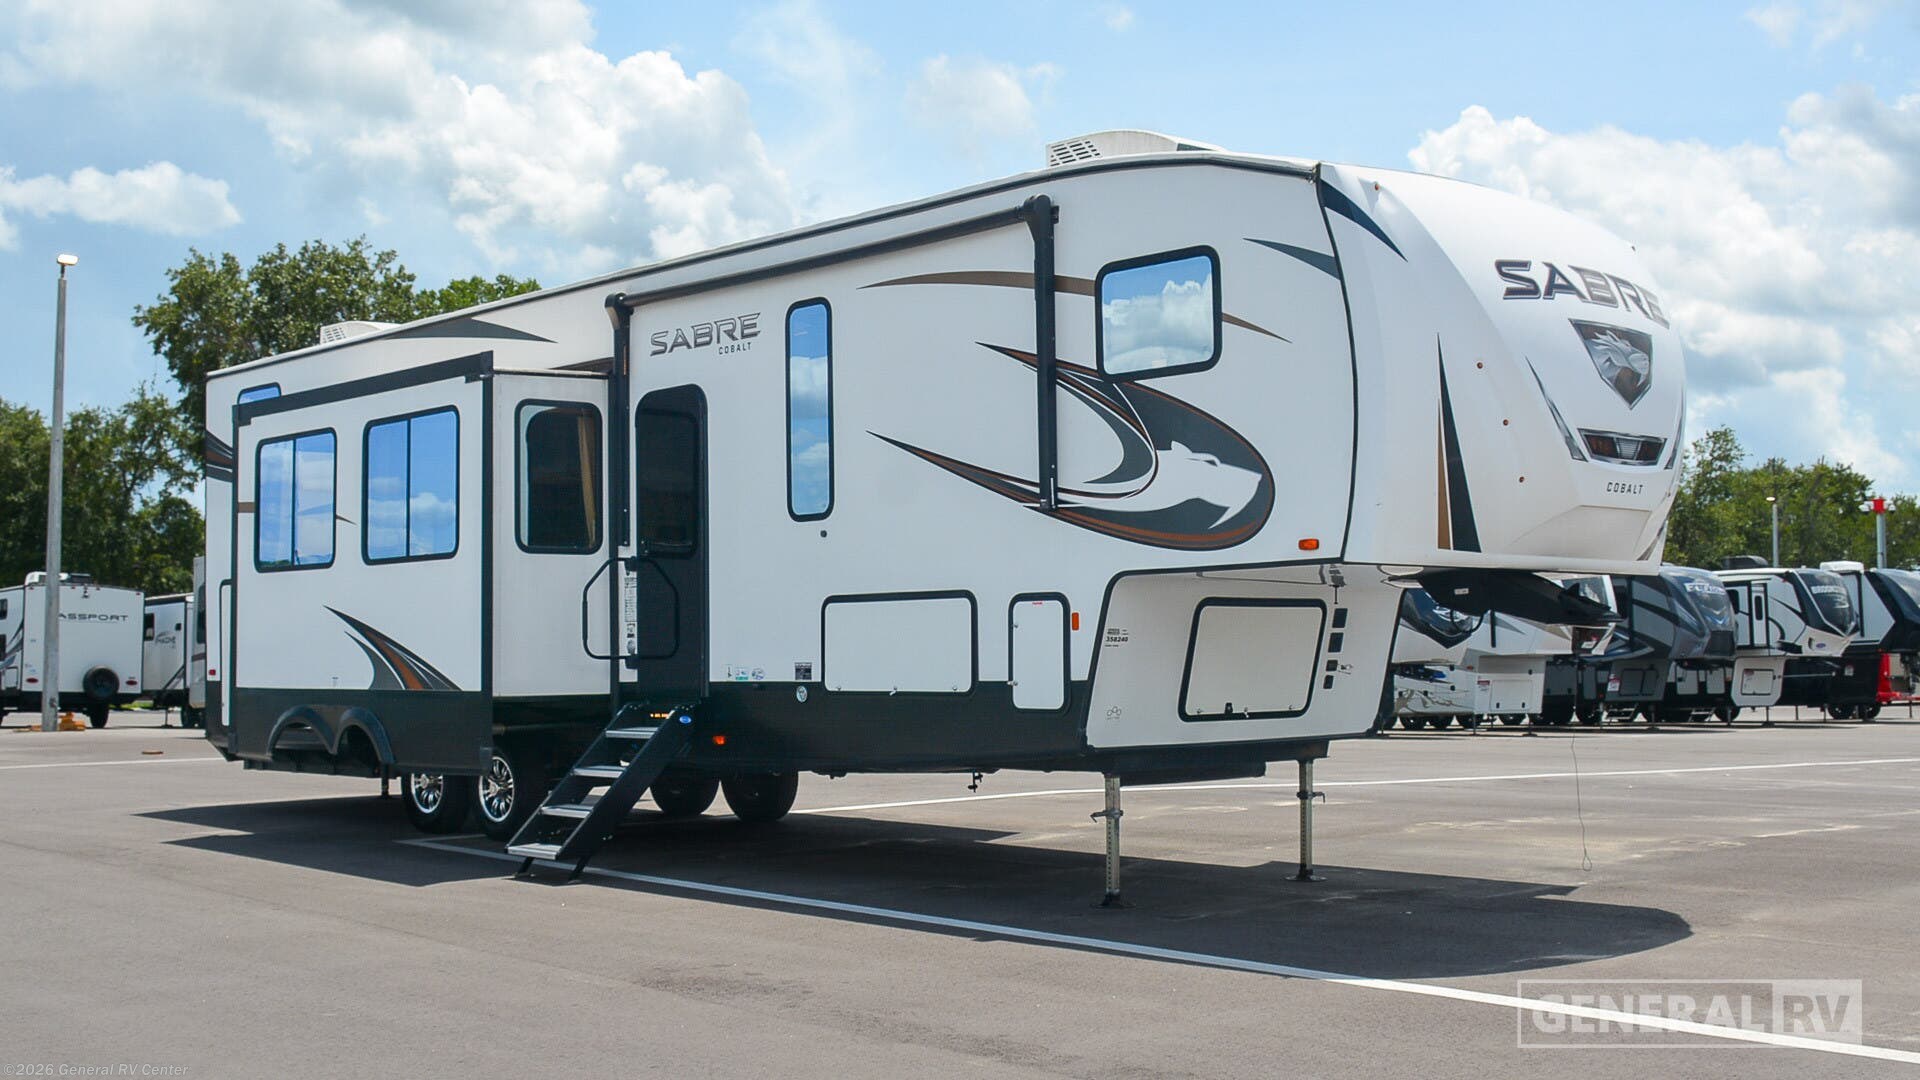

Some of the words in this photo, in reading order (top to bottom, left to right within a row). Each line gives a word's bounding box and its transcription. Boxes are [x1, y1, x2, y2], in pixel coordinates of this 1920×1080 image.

[1494, 259, 1670, 330] SABRE
[650, 312, 761, 356] SABRE
[718, 342, 752, 354] COBALT
[1606, 481, 1643, 494] COBALT
[58, 613, 128, 621] ASSPORT
